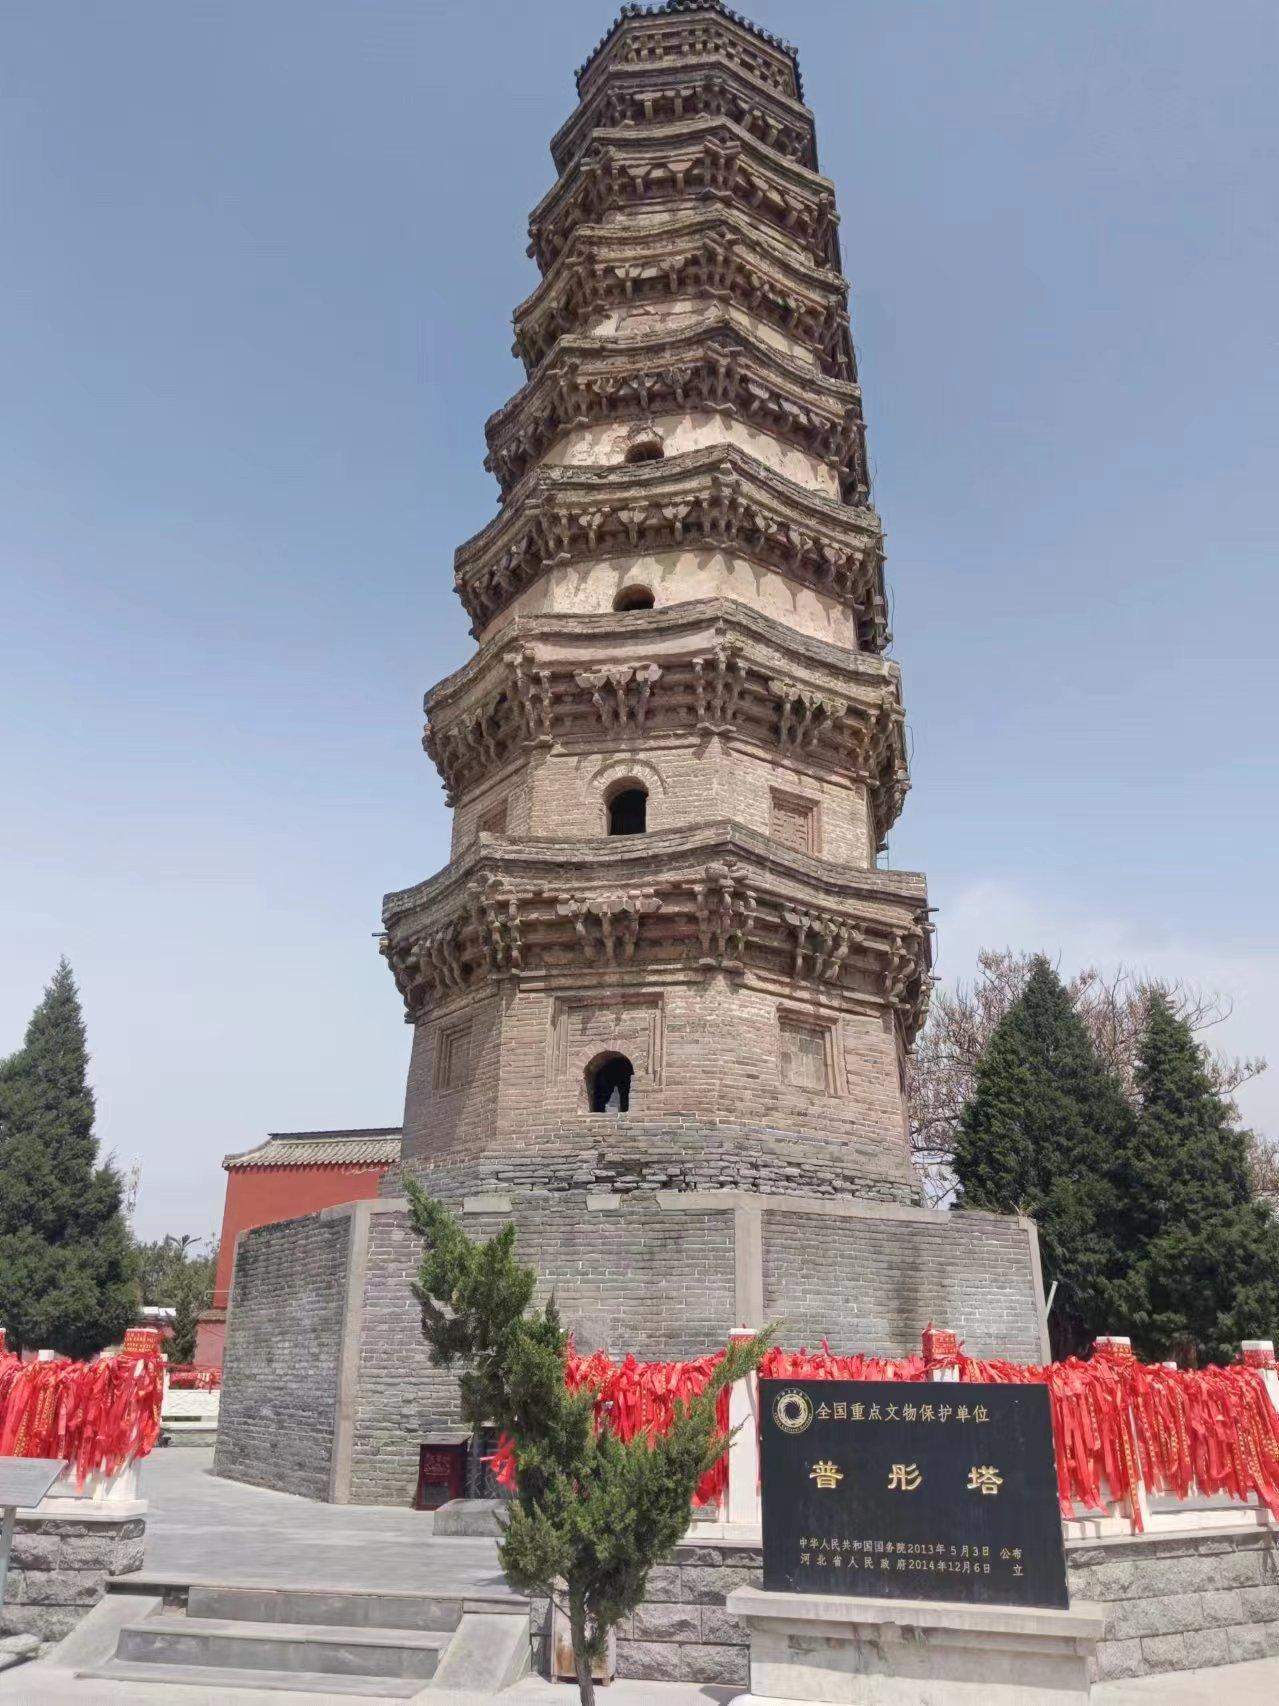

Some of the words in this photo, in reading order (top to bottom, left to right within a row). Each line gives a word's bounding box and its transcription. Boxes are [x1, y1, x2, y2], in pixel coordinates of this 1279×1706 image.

[816, 1401, 990, 1423] 全国重点文物保护单位
[809, 1460, 1003, 1494] 普彤塔
[1000, 1547, 1022, 1560] 公布
